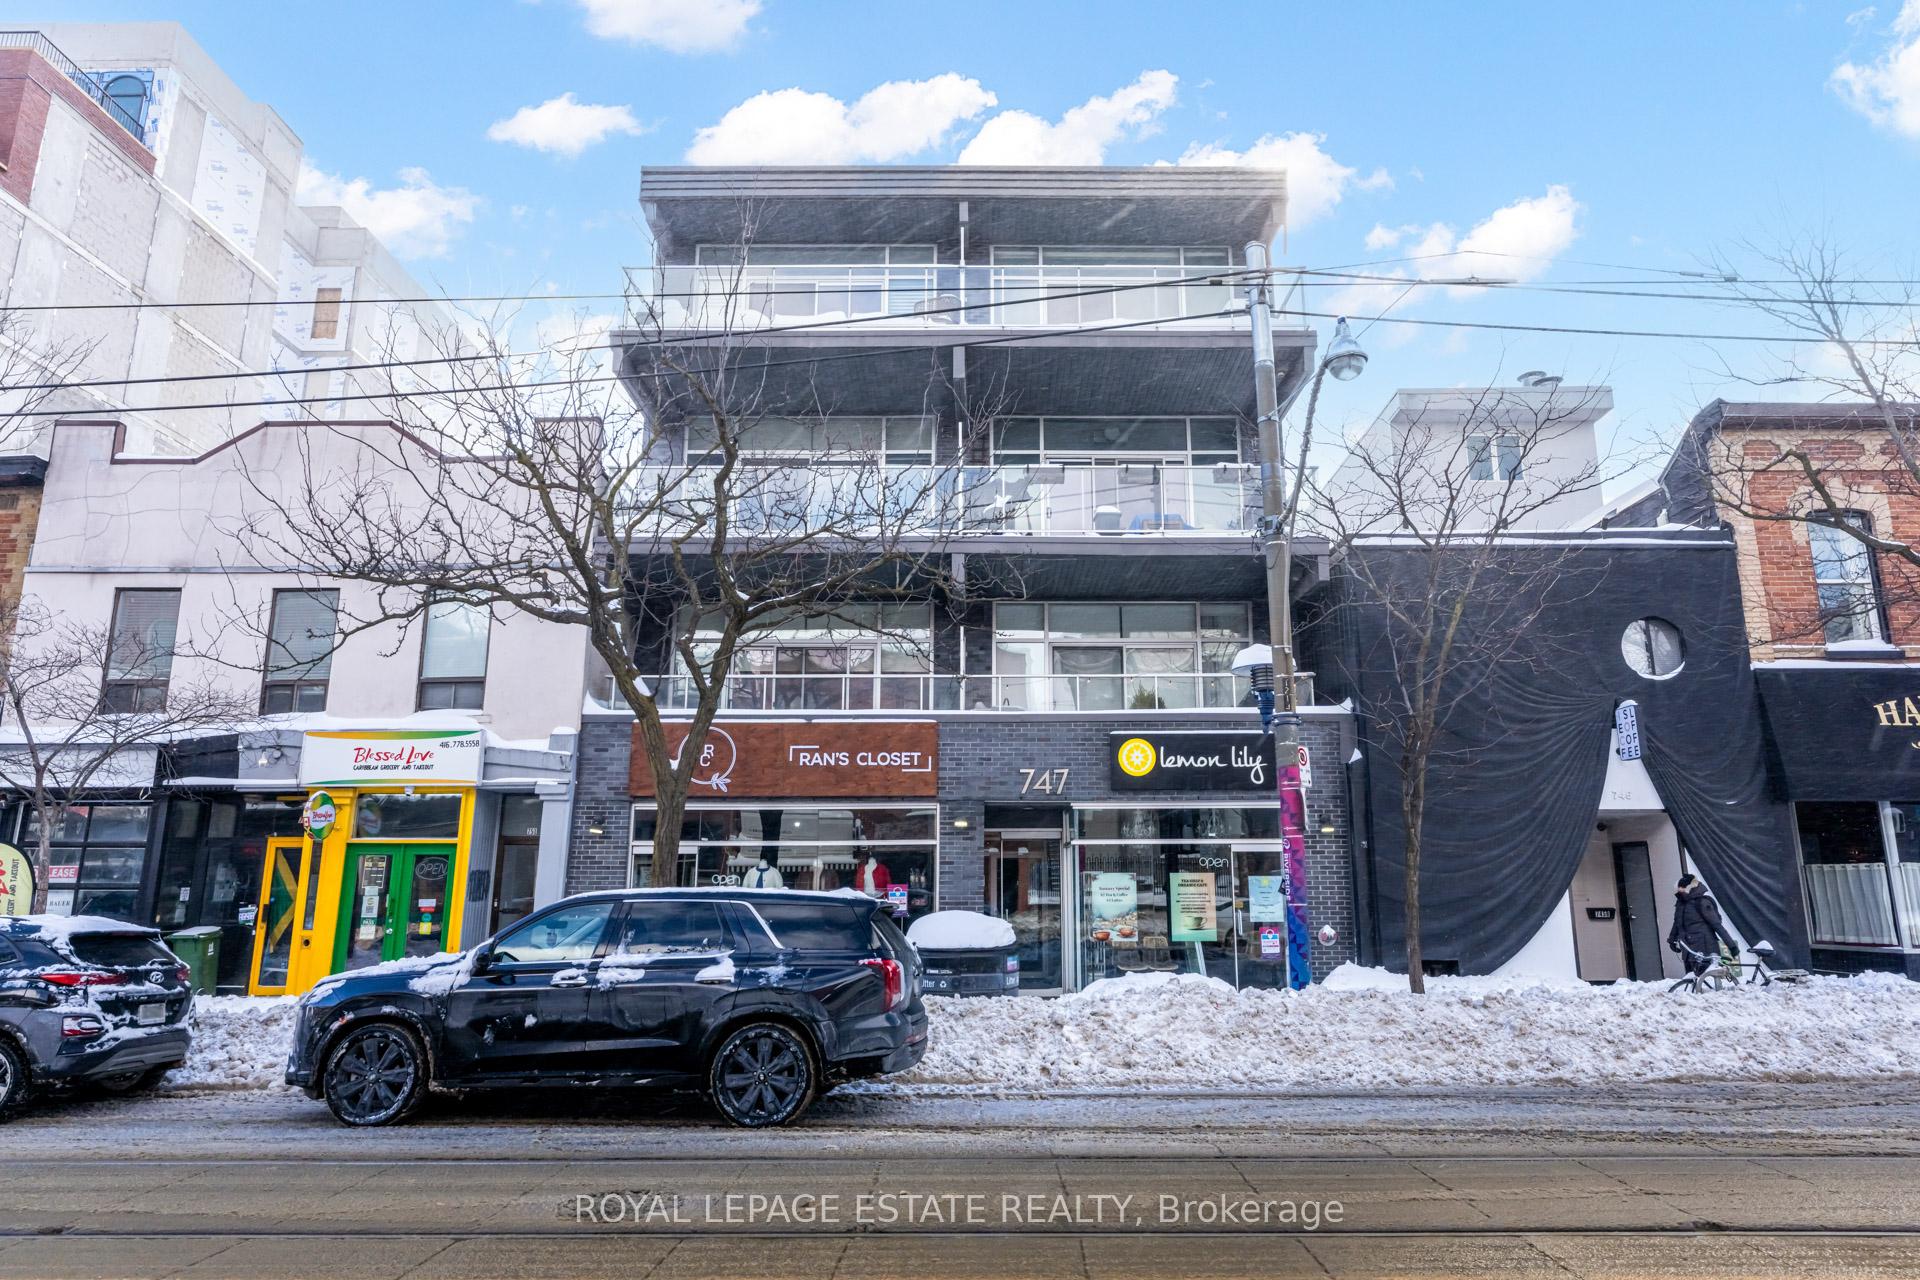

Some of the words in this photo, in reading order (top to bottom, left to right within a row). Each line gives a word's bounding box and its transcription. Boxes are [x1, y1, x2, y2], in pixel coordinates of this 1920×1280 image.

[1873, 696, 1920, 726] HA
[440, 740, 480, 748] 416.778.5558
[1621, 746, 1640, 758] FEE
[354, 747, 405, 763] Blessed
[406, 746, 434, 764] Love
[800, 752, 849, 766] RAN'S
[856, 752, 921, 766] CLOSET
[1160, 746, 1227, 768] lemon
[1231, 746, 1268, 784] lily
[1019, 768, 1069, 795] 747
[417, 863, 448, 875] OPEN
[1199, 857, 1229, 869] open
[1283, 853, 1292, 901] RIVERSIDE
